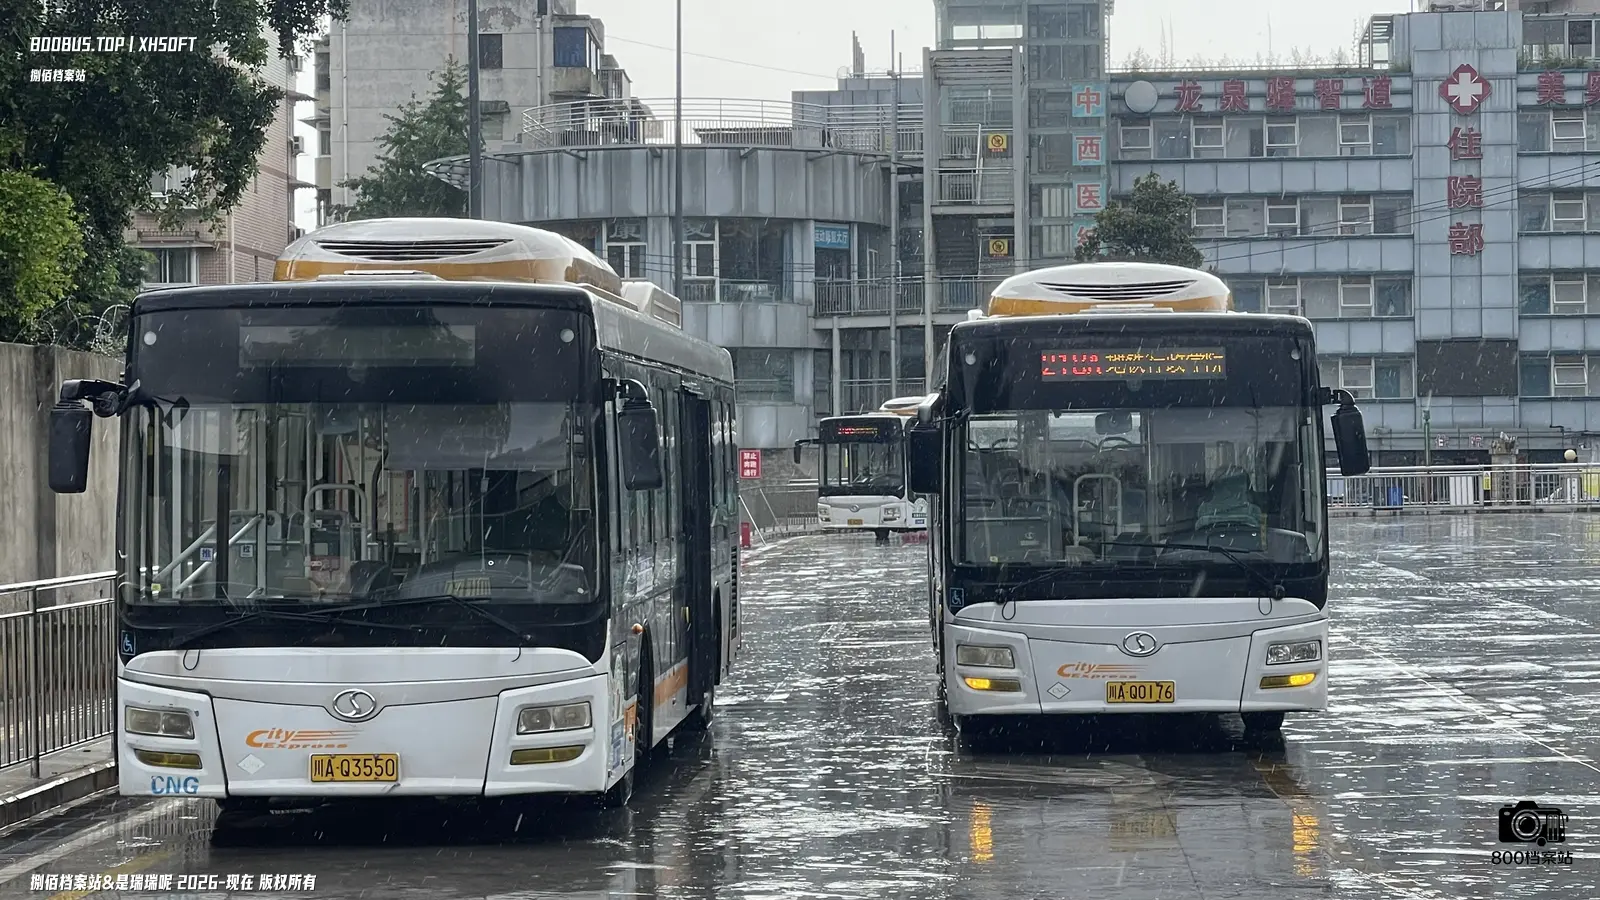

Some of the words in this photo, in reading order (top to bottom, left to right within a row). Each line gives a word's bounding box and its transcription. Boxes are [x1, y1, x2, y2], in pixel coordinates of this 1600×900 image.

[1446, 126, 1485, 256] 住院部
[1056, 662, 1097, 678] City
[245, 728, 295, 748] City
[151, 775, 200, 794] CNG
